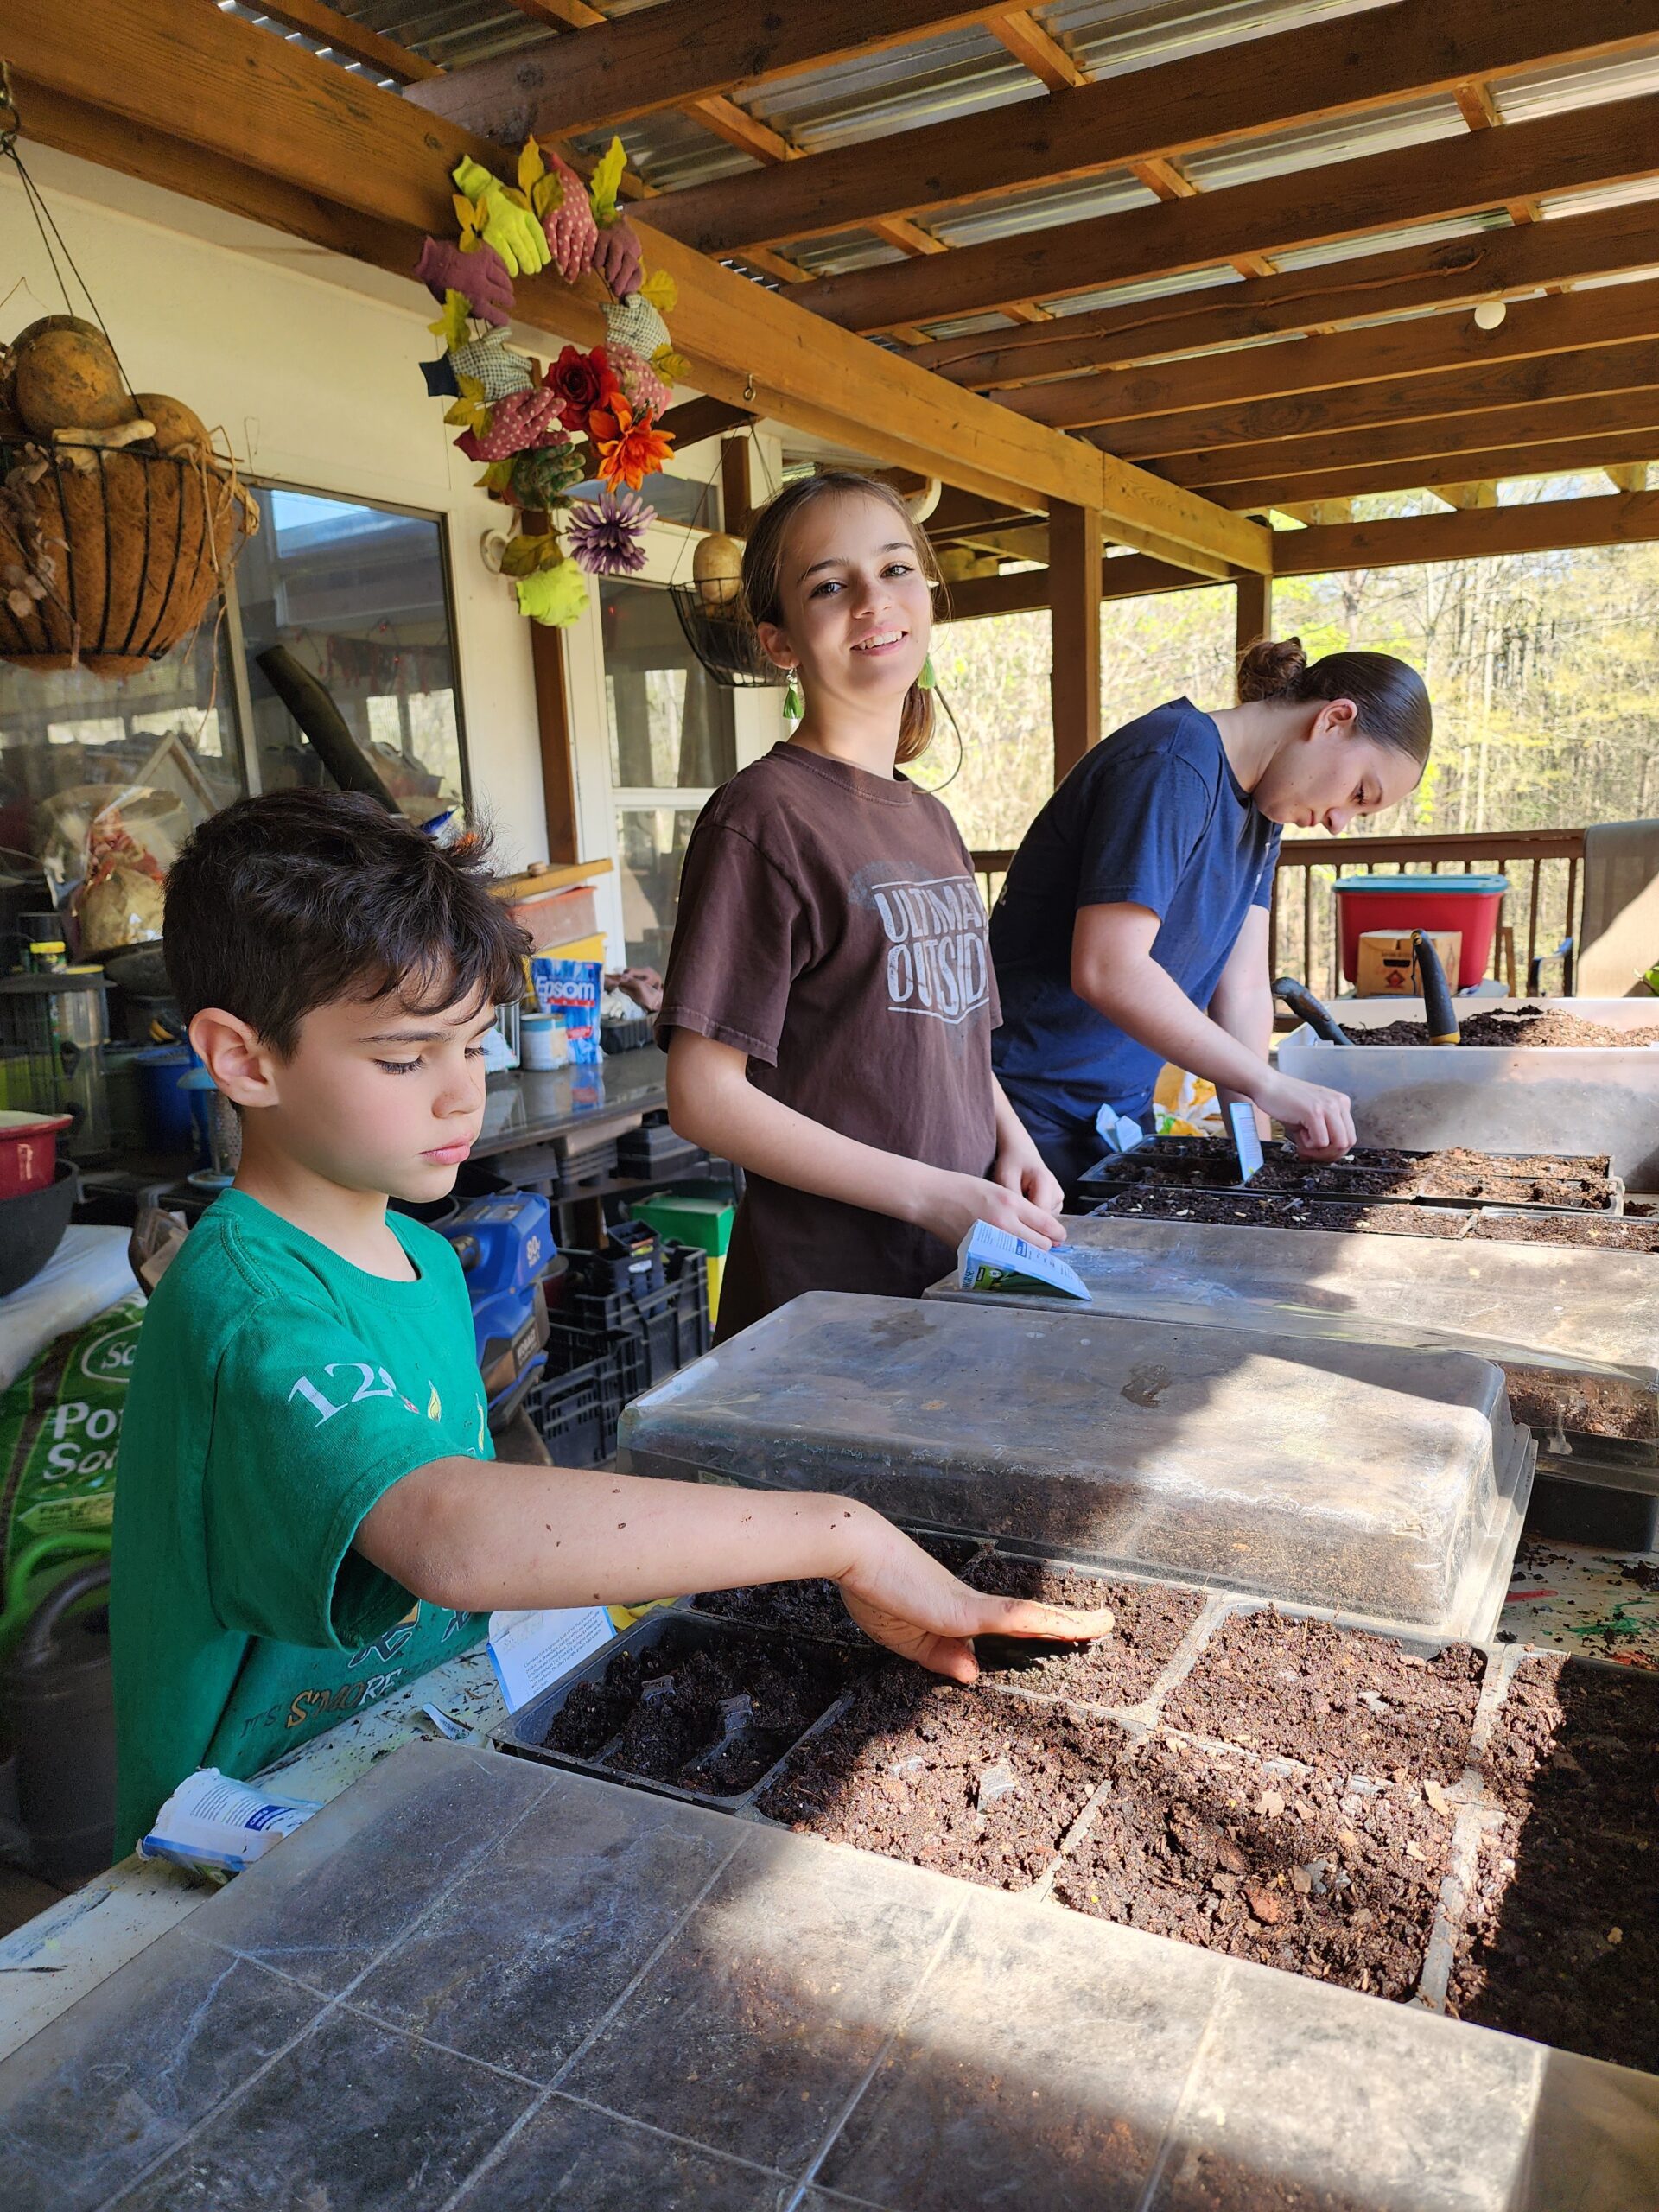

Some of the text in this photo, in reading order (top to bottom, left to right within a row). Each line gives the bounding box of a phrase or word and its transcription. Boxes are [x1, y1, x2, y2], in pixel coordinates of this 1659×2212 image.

[536, 975, 595, 1001] Epsom
[887, 931, 988, 1016] OUTSID
[53, 1396, 124, 1440] Po
[288, 1363, 397, 1428] 12
